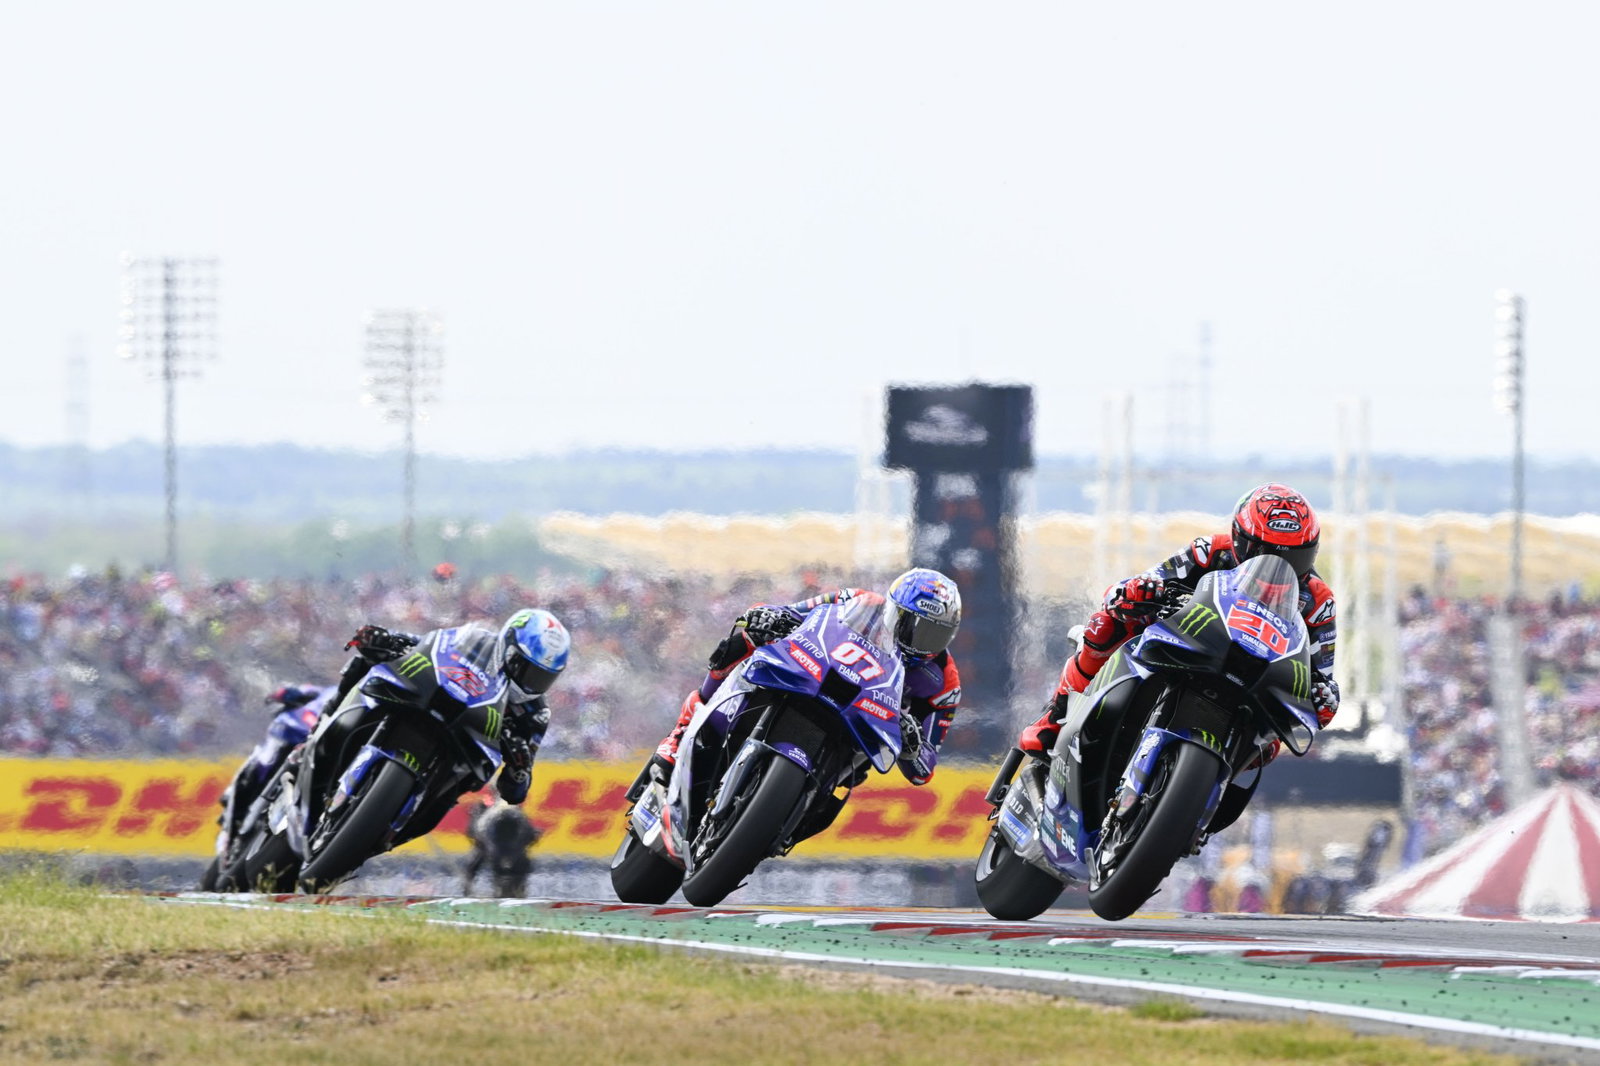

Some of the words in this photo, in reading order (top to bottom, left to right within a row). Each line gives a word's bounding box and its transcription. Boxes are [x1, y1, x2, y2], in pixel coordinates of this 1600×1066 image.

[1271, 521, 1298, 530] HJC
[920, 600, 941, 614] SHOEI
[1247, 602, 1288, 634] ENEOS
[1226, 604, 1290, 656] 20
[795, 633, 824, 659] prima
[848, 633, 881, 659] prima
[791, 650, 821, 676] MOTUL
[830, 642, 885, 680] 07
[838, 664, 861, 684] FIAMM
[860, 699, 889, 719] MOTUL
[872, 690, 899, 711] prima
